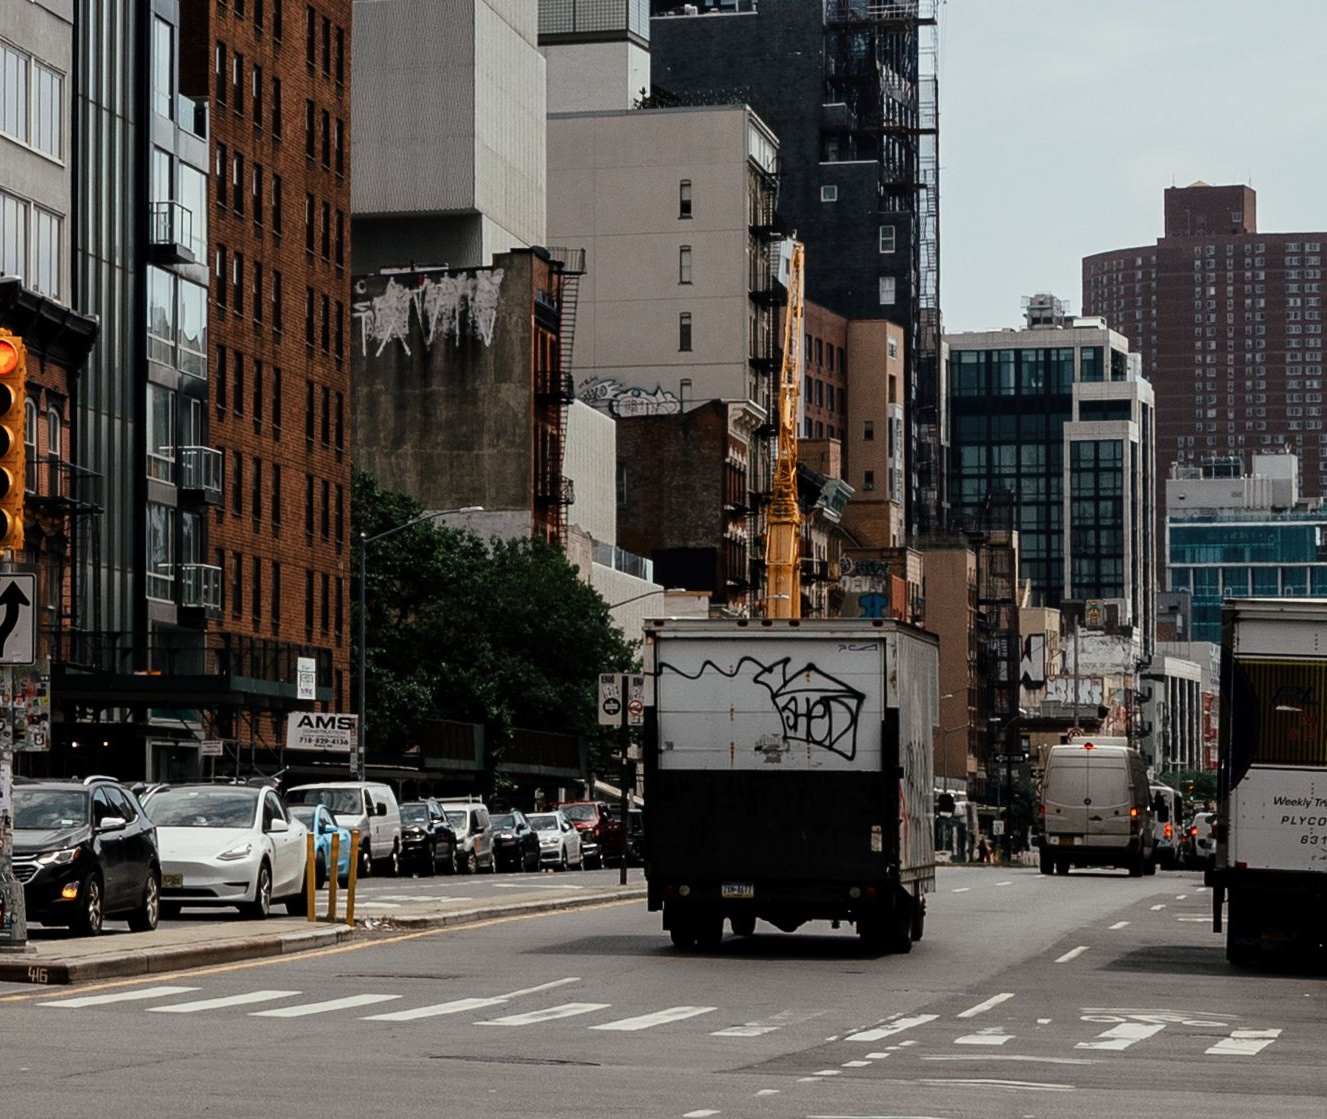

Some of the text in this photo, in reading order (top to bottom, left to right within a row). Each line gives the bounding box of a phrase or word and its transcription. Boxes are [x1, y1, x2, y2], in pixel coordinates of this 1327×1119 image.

[297, 715, 353, 730] AMS
[1273, 796, 1312, 809] Weekly
[1300, 835, 1327, 845] 631
[27, 965, 48, 983] 416
